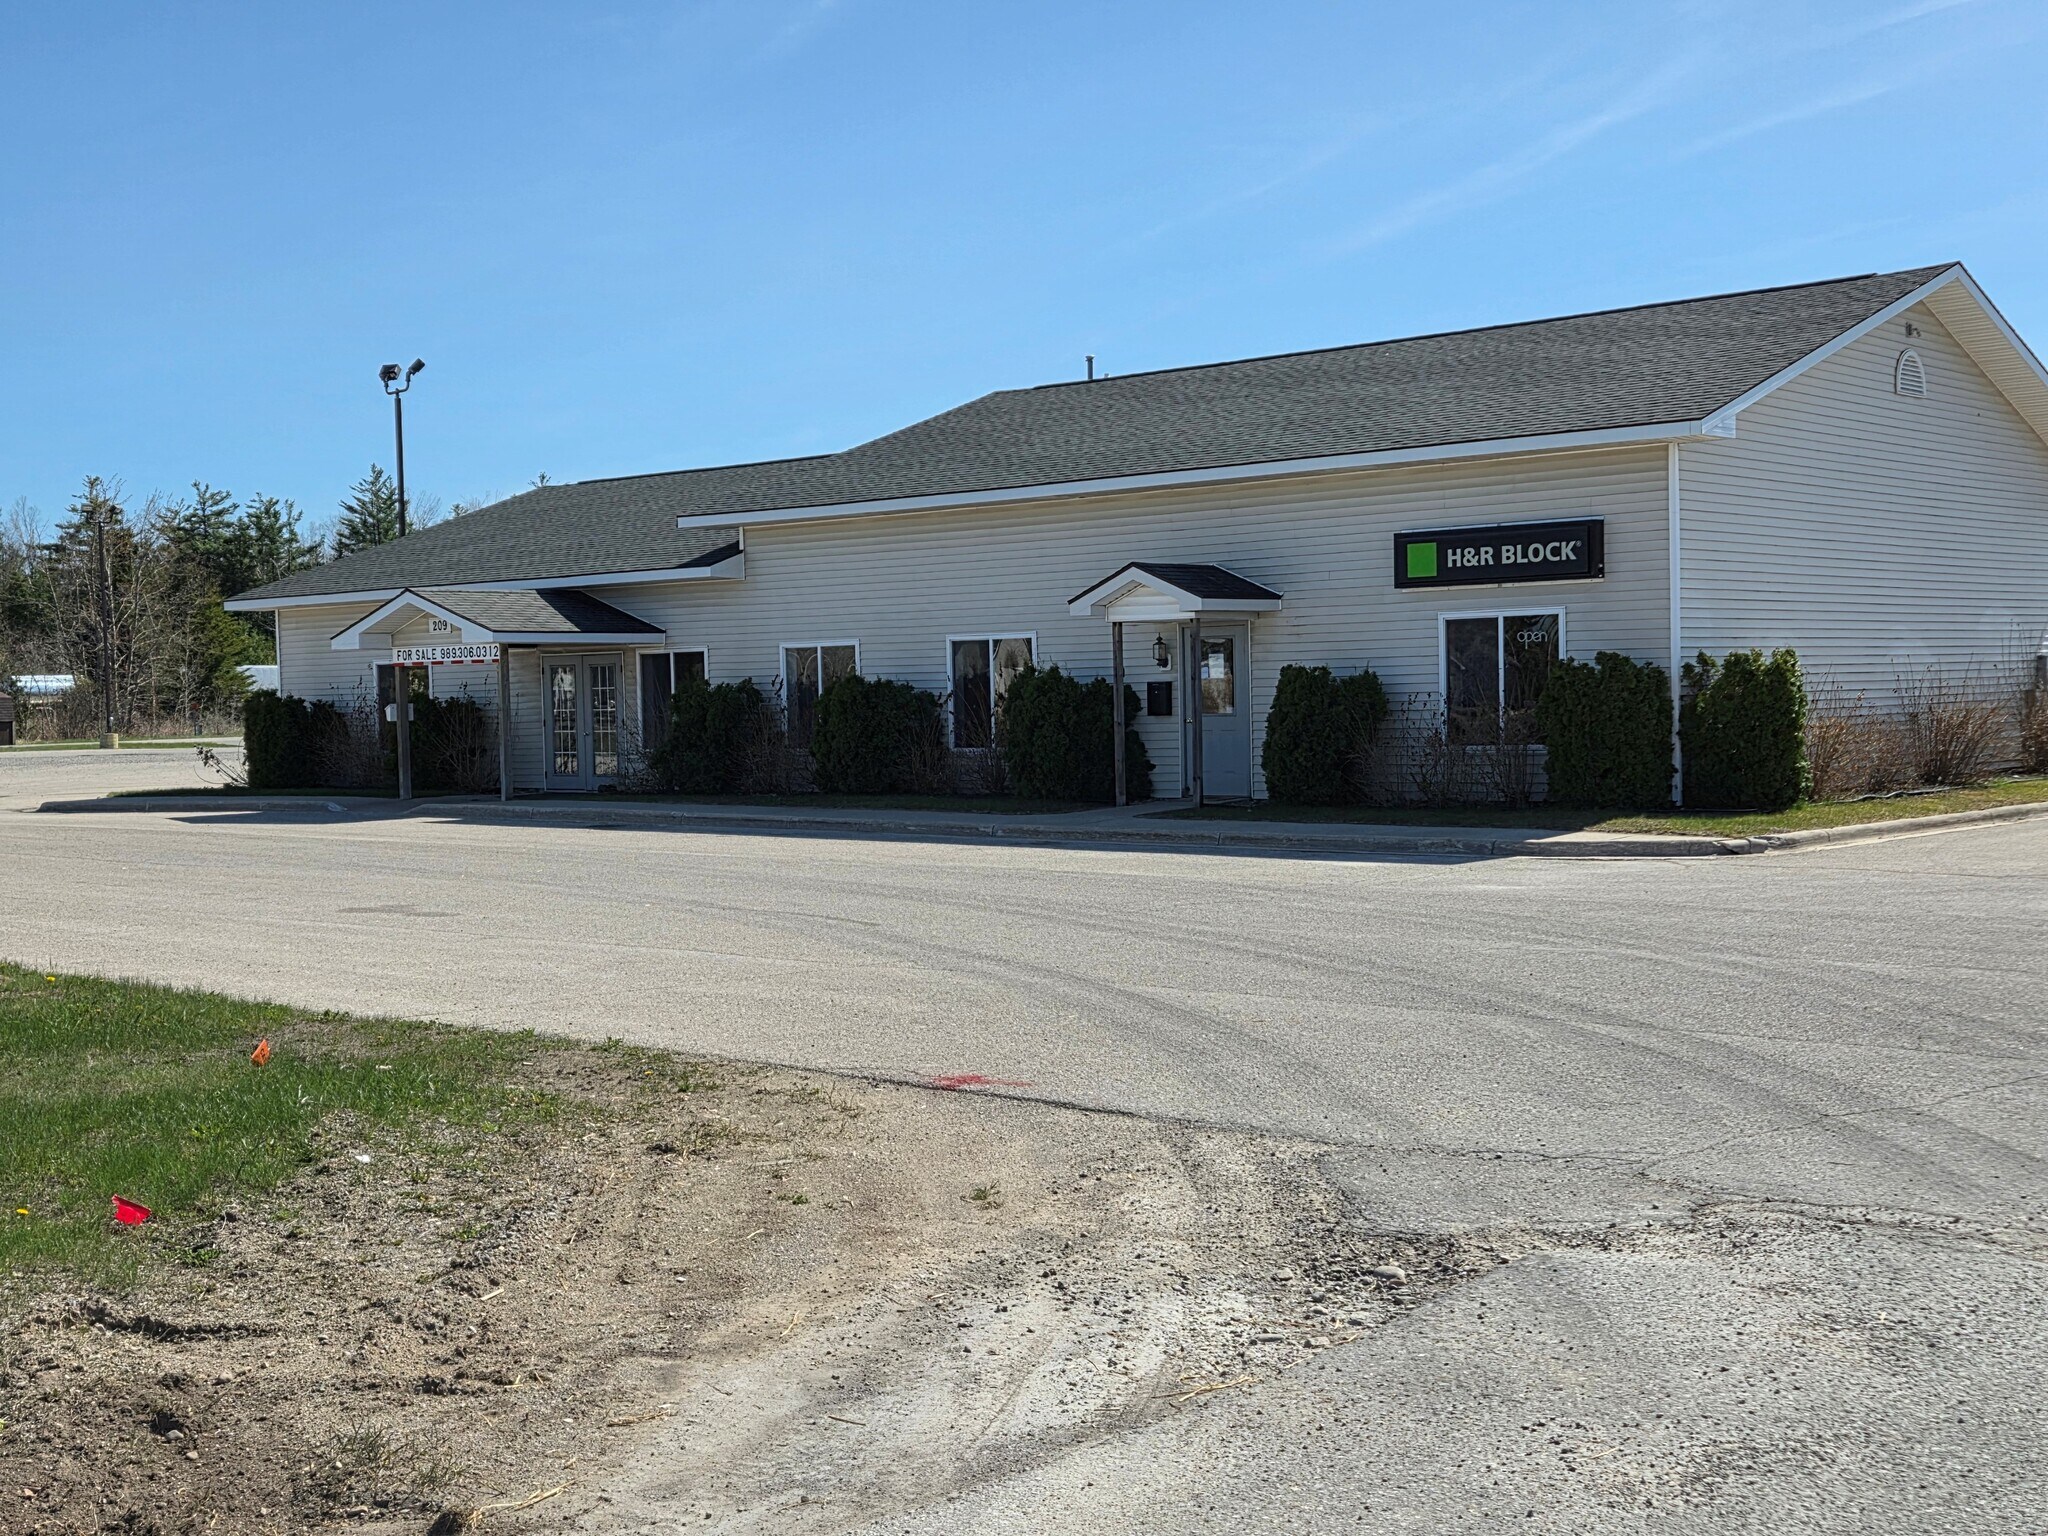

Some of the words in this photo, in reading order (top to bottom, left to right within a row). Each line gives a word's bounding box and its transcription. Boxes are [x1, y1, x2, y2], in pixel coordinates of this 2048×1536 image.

[1447, 546, 1494, 567] H&R
[1501, 540, 1577, 564] BLOCK
[432, 620, 448, 631] 209
[1517, 631, 1548, 649] open
[397, 650, 413, 661] FOR
[415, 648, 437, 660] SALE
[440, 646, 499, 659] 989.306.0312
